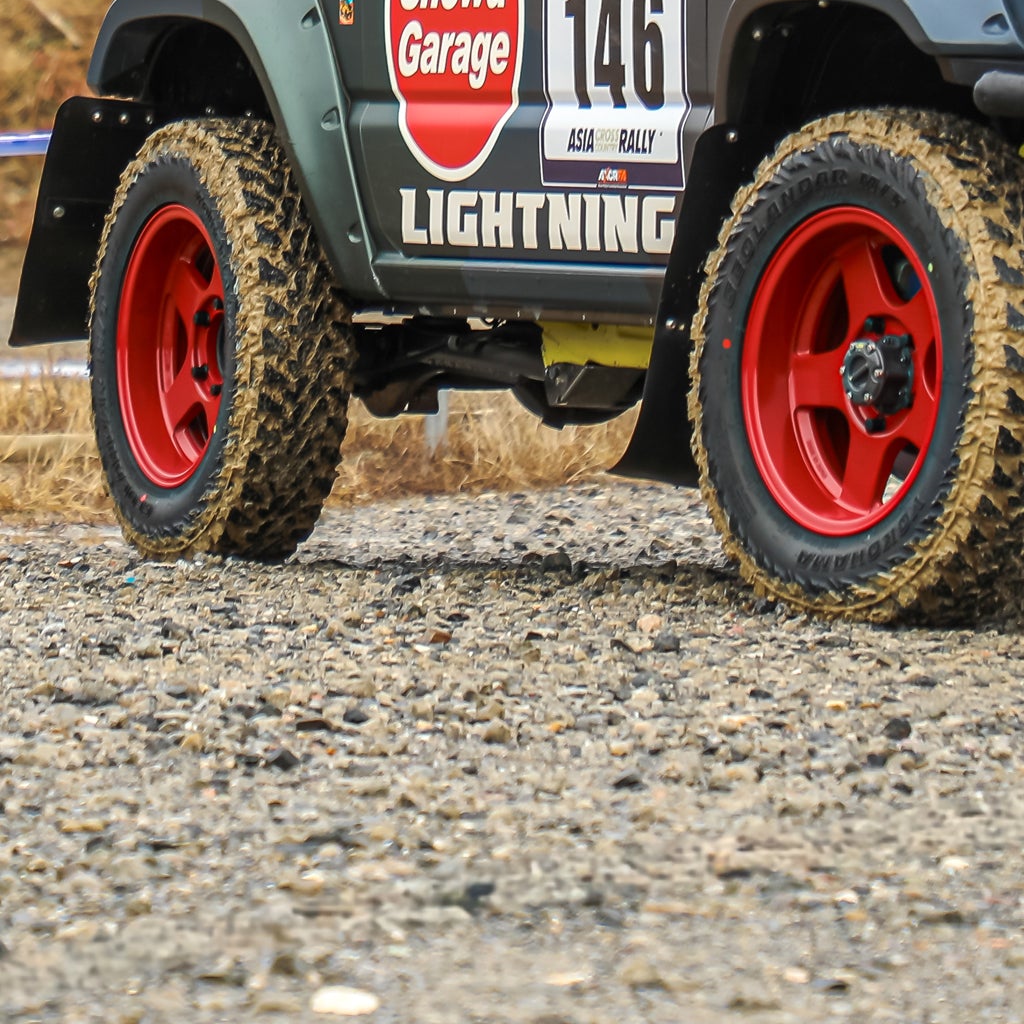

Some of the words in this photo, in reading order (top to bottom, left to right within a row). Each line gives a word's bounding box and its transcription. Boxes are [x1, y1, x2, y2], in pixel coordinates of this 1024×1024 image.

[399, 20, 511, 90] Garage
[567, 128, 594, 153] ASIA
[618, 129, 657, 154] RALLY
[399, 187, 676, 254] LIGHTNING
